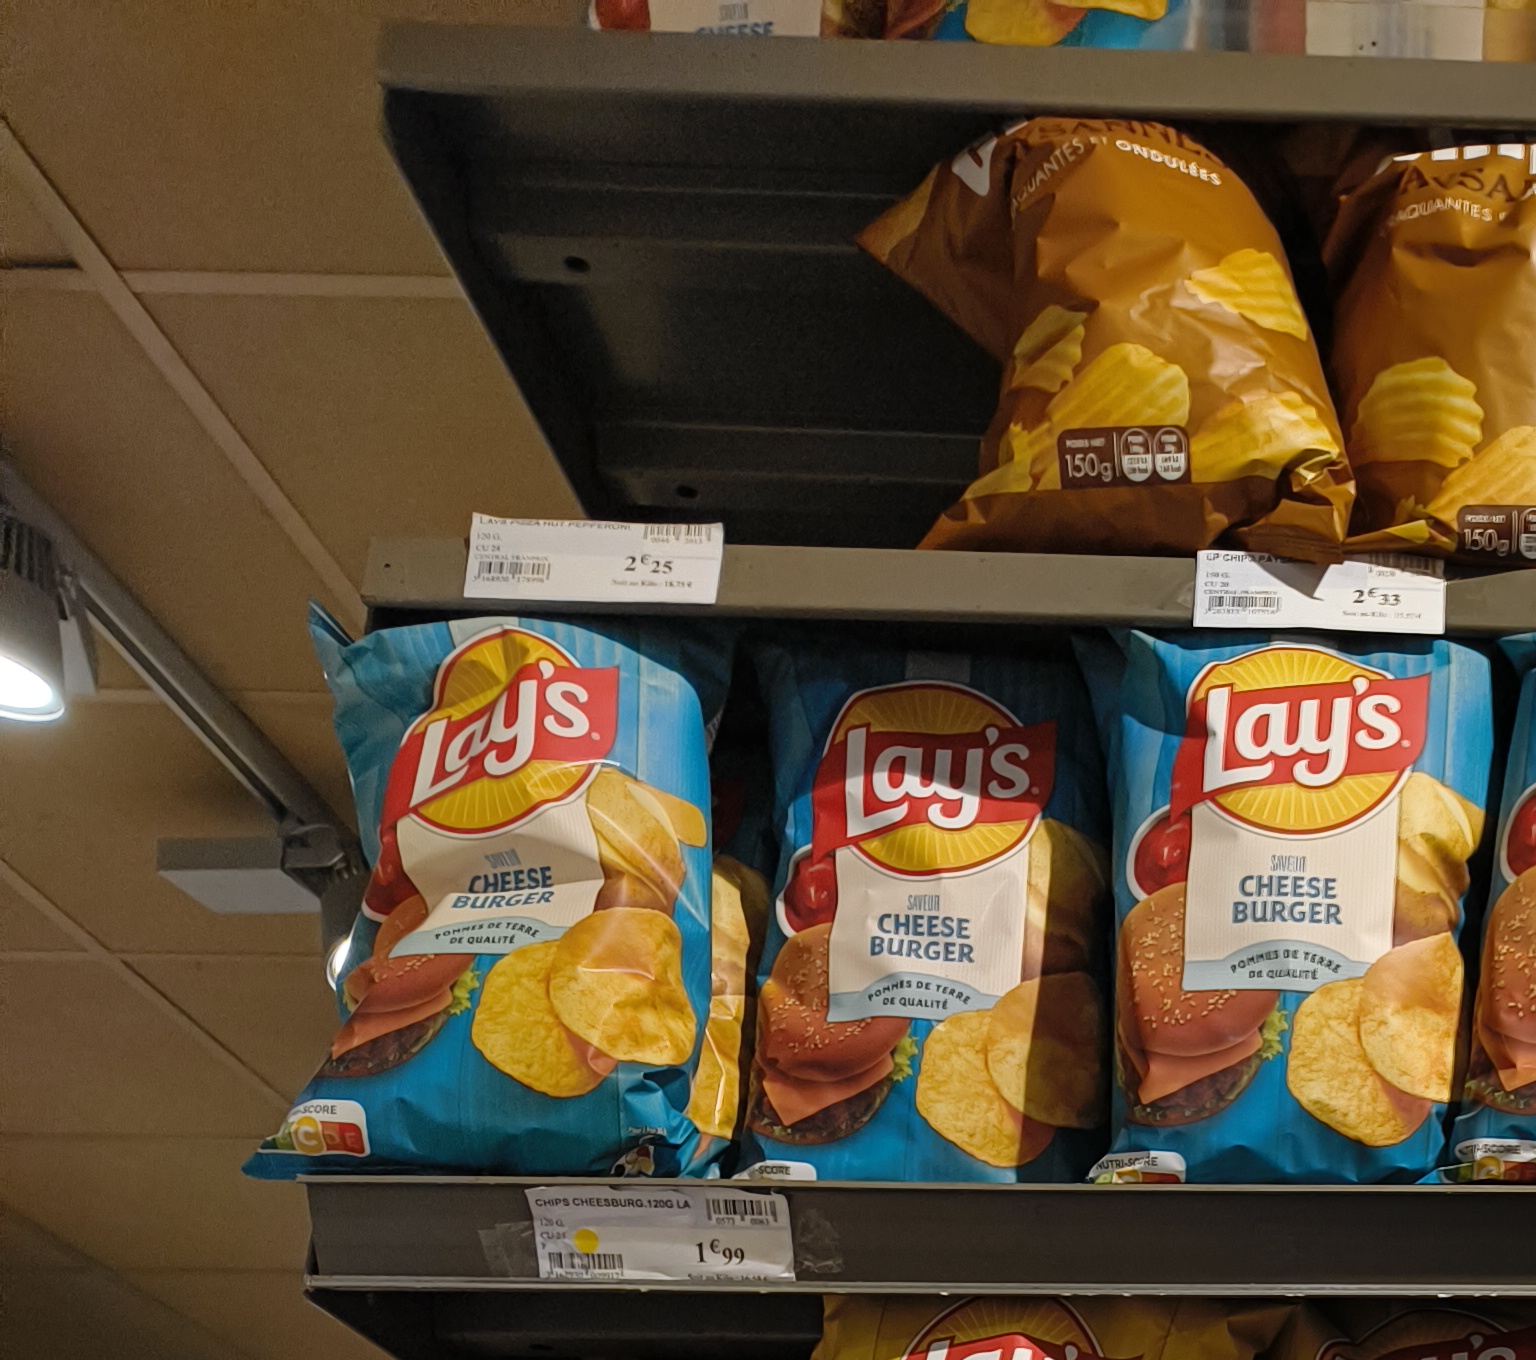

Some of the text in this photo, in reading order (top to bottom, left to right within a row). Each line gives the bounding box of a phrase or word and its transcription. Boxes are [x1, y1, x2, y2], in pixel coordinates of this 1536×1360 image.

[1115, 139, 1222, 187] ONDULÉES
[1066, 452, 1113, 482] 150g
[407, 658, 591, 809] Lay's
[1203, 675, 1402, 793] Lay's
[466, 865, 555, 894] CHEESE
[1238, 874, 1338, 900] CHEESE
[450, 890, 555, 911] BURGER
[1231, 899, 1343, 927] BURGER
[535, 1199, 570, 1207] CHIPS
[676, 1200, 691, 1209] LA
